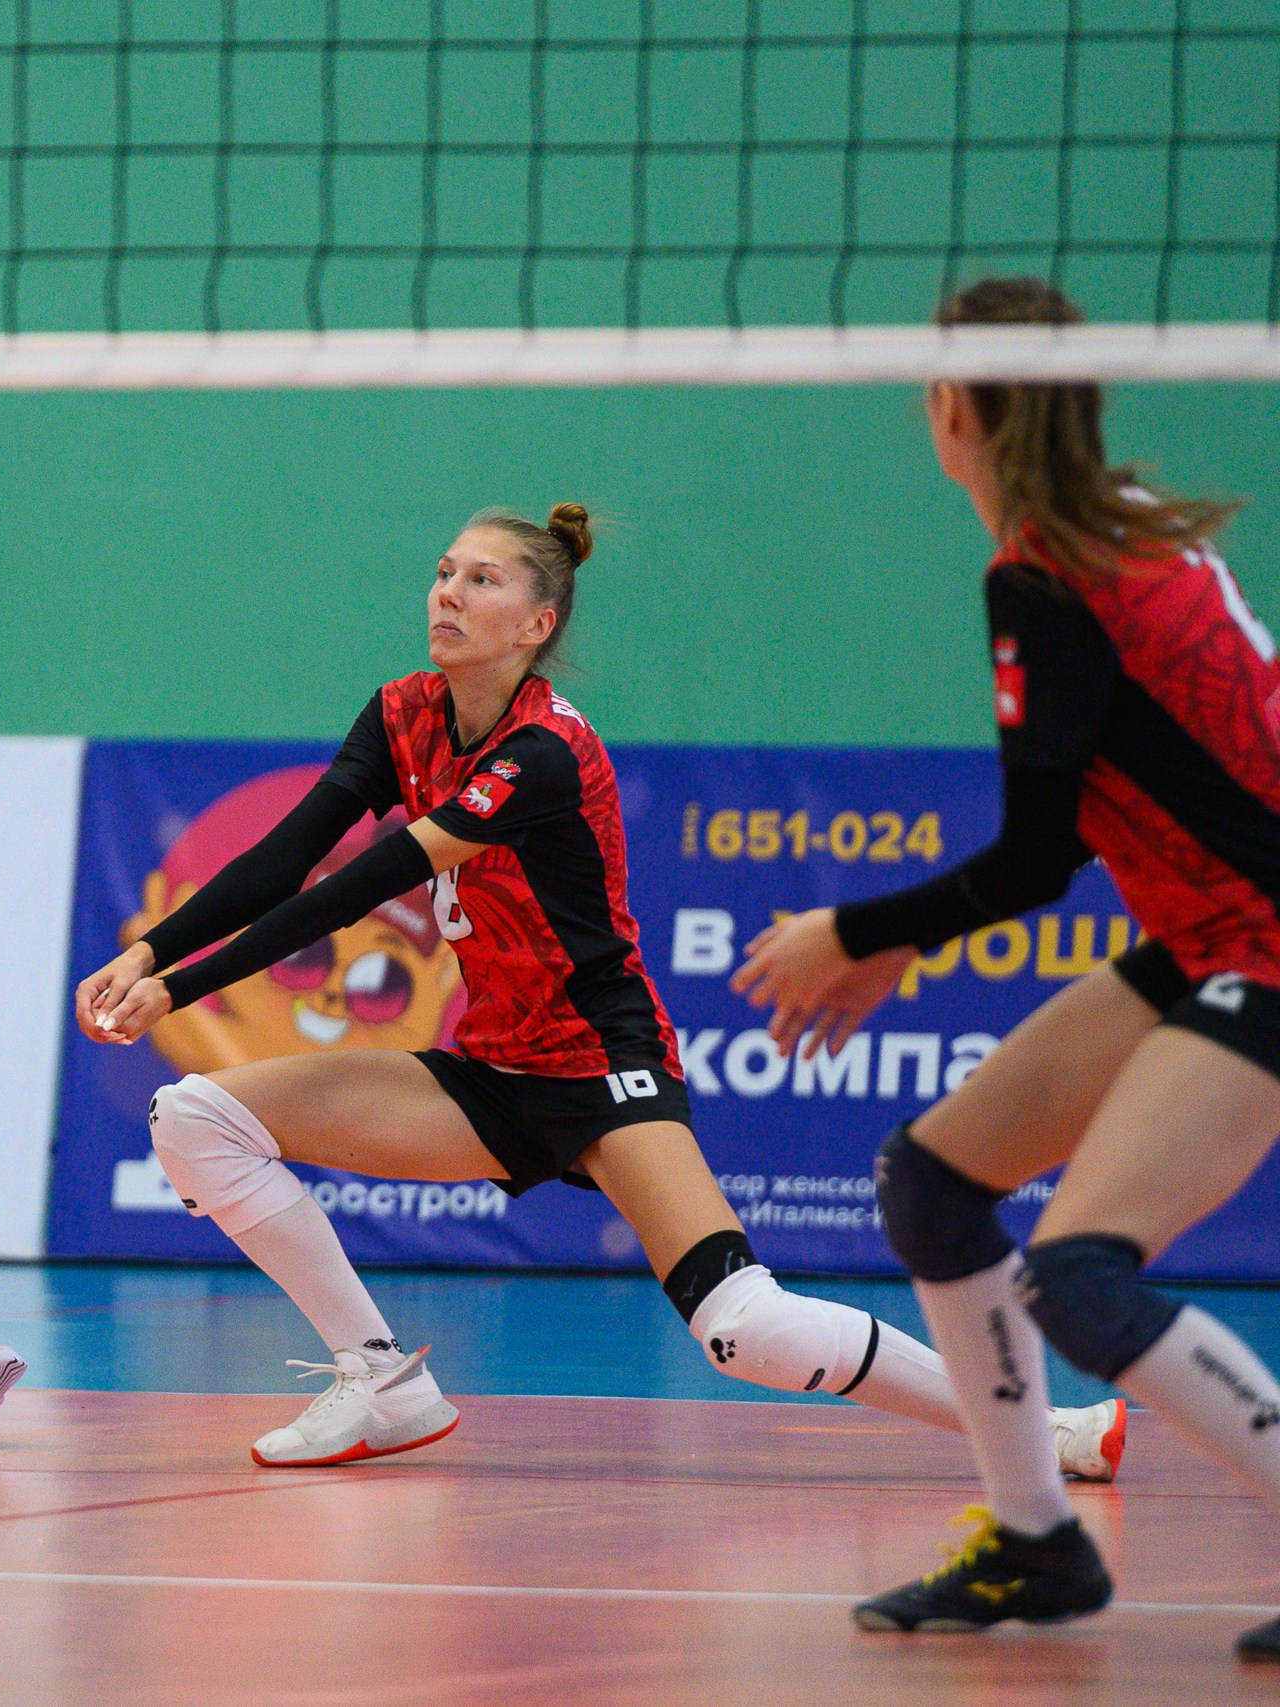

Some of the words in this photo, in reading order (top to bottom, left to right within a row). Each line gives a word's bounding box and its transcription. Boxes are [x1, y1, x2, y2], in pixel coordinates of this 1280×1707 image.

[706, 808, 943, 863] 651-024
[604, 1069, 659, 1105] 10
[682, 1027, 1002, 1099] компа
